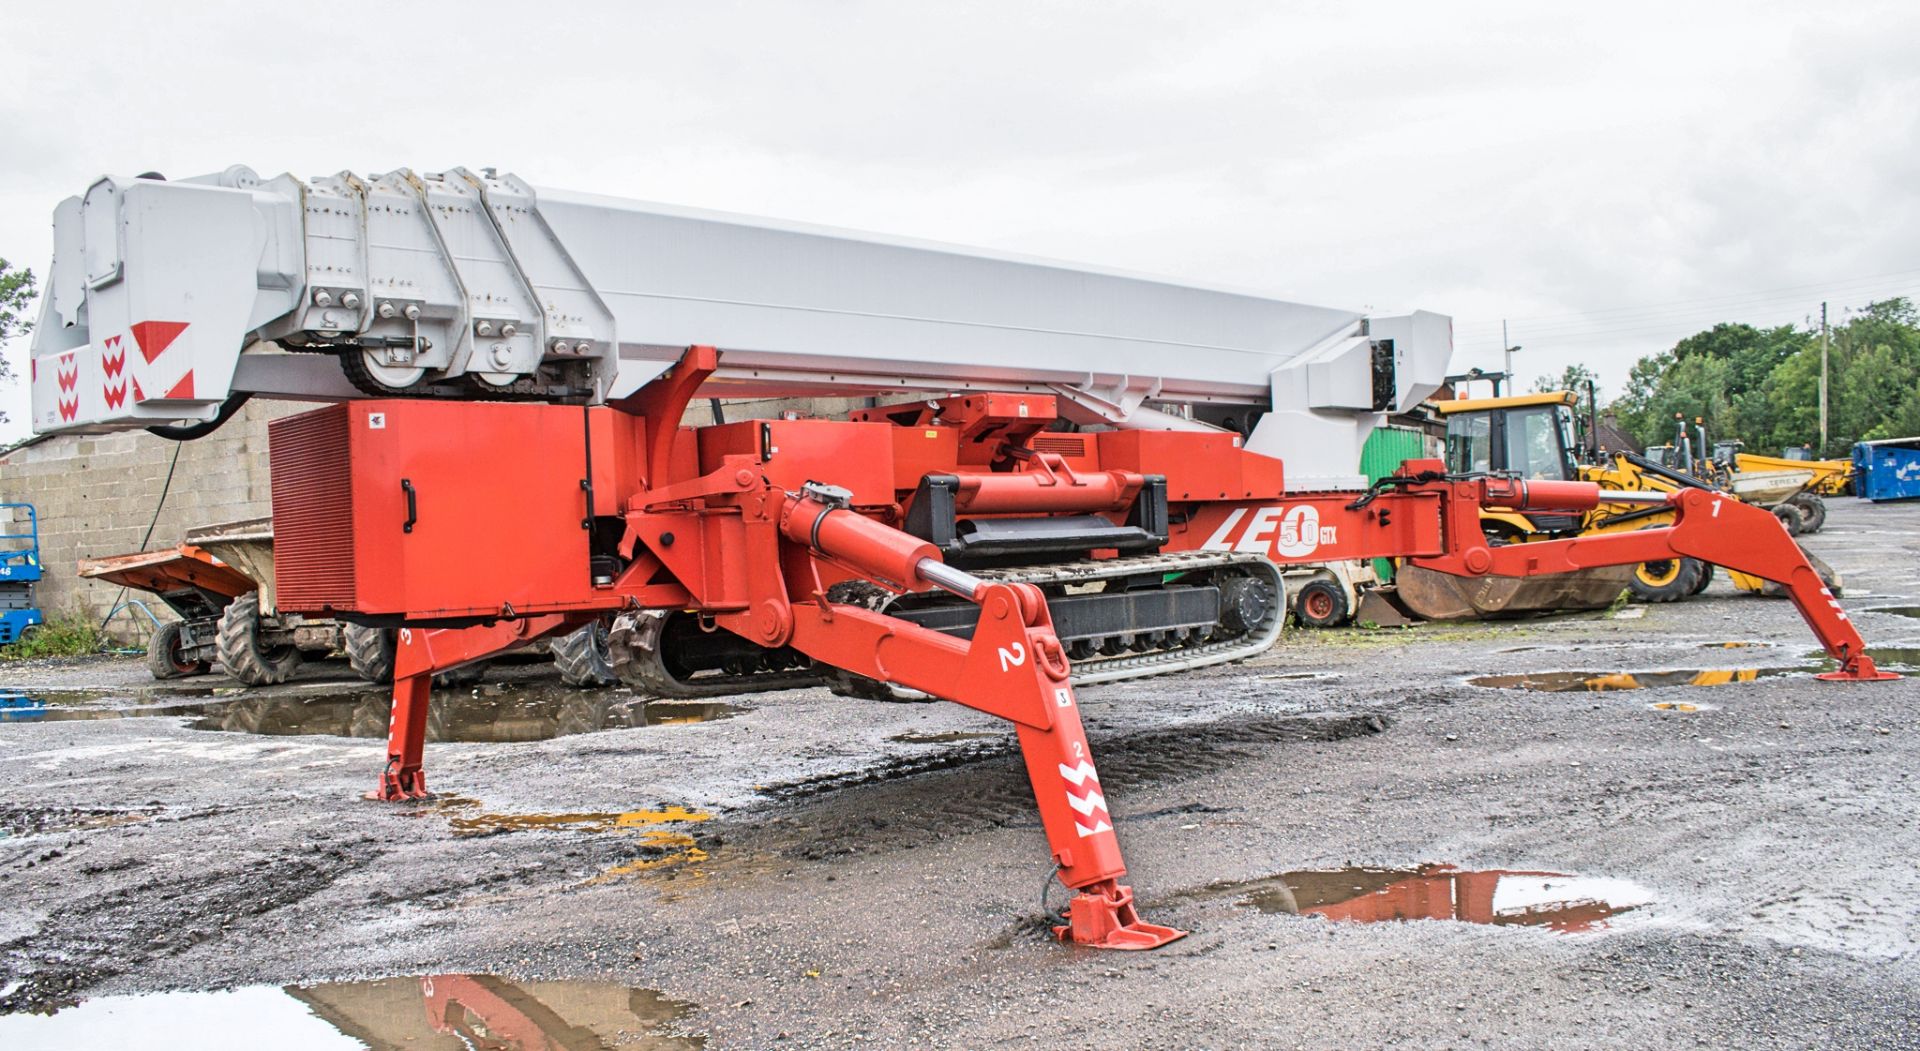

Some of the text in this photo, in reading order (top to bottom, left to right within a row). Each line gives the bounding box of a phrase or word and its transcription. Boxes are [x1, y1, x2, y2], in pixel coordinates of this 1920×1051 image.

[1768, 478, 1799, 487] TEREX
[1711, 499, 1722, 518] 1
[1320, 526, 1338, 545] GTX
[401, 628, 411, 645] 3
[998, 642, 1026, 672] 2
[1073, 741, 1084, 757] 2
